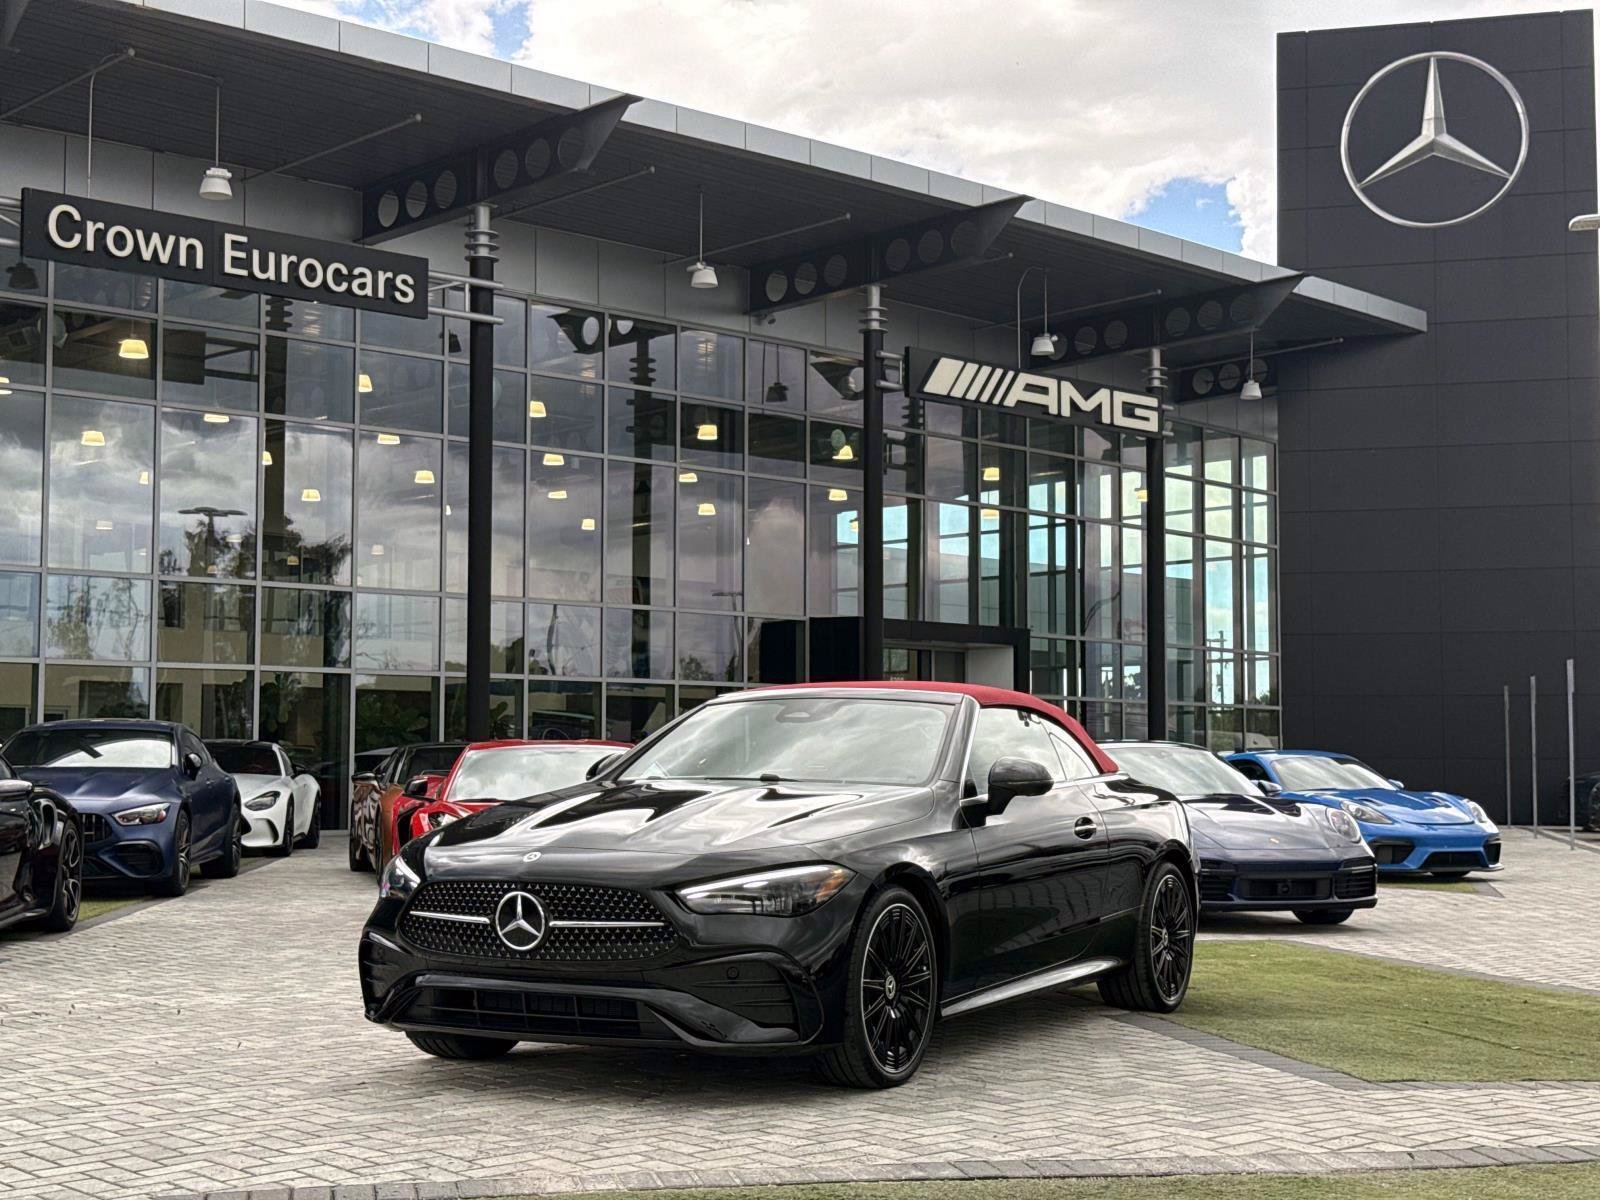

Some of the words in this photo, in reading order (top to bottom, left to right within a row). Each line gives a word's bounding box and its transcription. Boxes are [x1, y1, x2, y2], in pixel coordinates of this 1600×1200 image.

[47, 204, 204, 270] Crown
[223, 232, 415, 304] Eurocars
[1003, 372, 1159, 433] AMG
